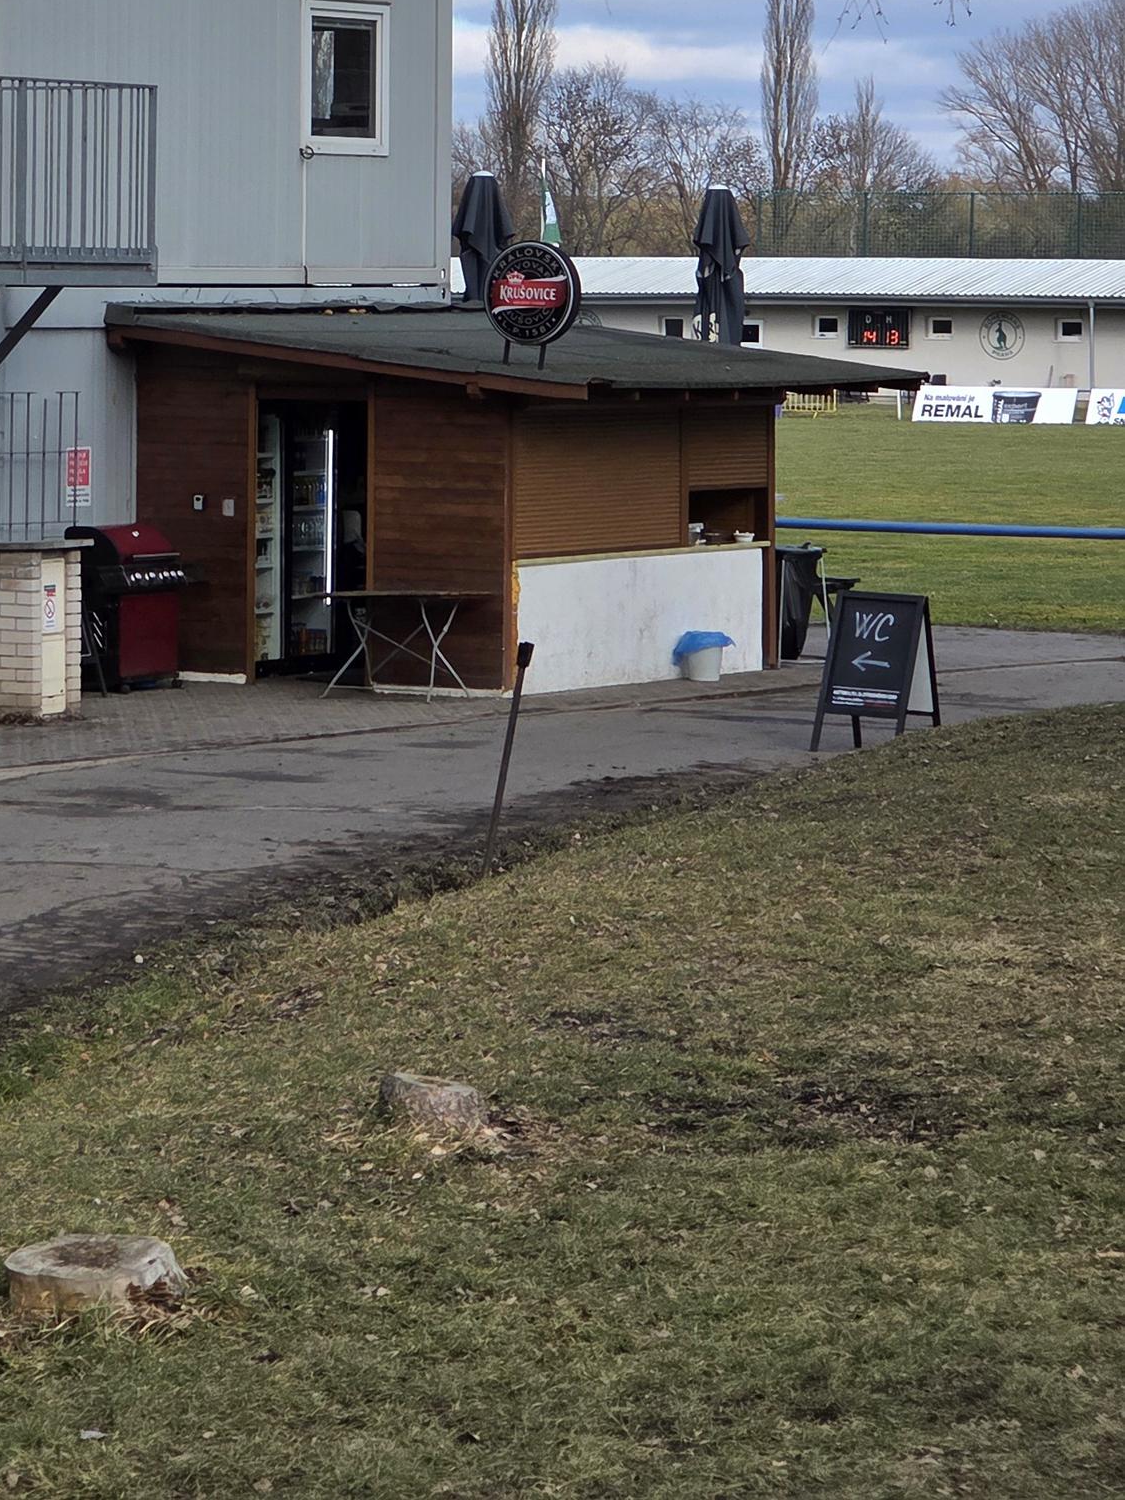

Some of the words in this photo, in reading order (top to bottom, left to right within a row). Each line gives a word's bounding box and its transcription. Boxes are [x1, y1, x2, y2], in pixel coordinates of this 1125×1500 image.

[500, 285, 557, 303] KRUŠOVICE
[885, 315, 893, 324] H
[863, 331, 876, 343] 14
[886, 329, 899, 345] 13
[921, 404, 984, 419] REMAL
[855, 611, 895, 642] WC
